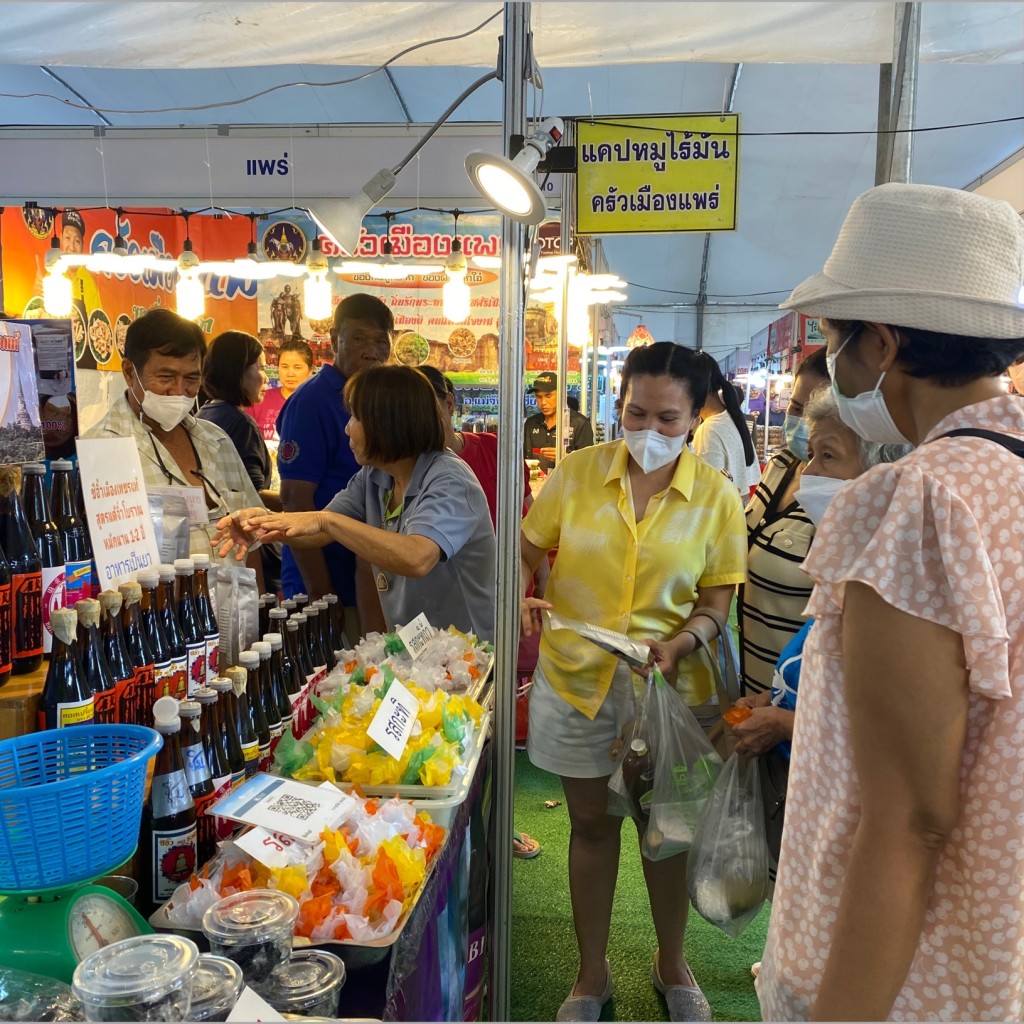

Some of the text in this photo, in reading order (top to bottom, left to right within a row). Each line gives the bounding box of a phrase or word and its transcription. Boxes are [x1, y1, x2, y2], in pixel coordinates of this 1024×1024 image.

[246, 152, 289, 176] แพร่
[582, 130, 731, 172] แคปหมูไร้มัน
[591, 184, 720, 213] ครัวเมืองแพร่
